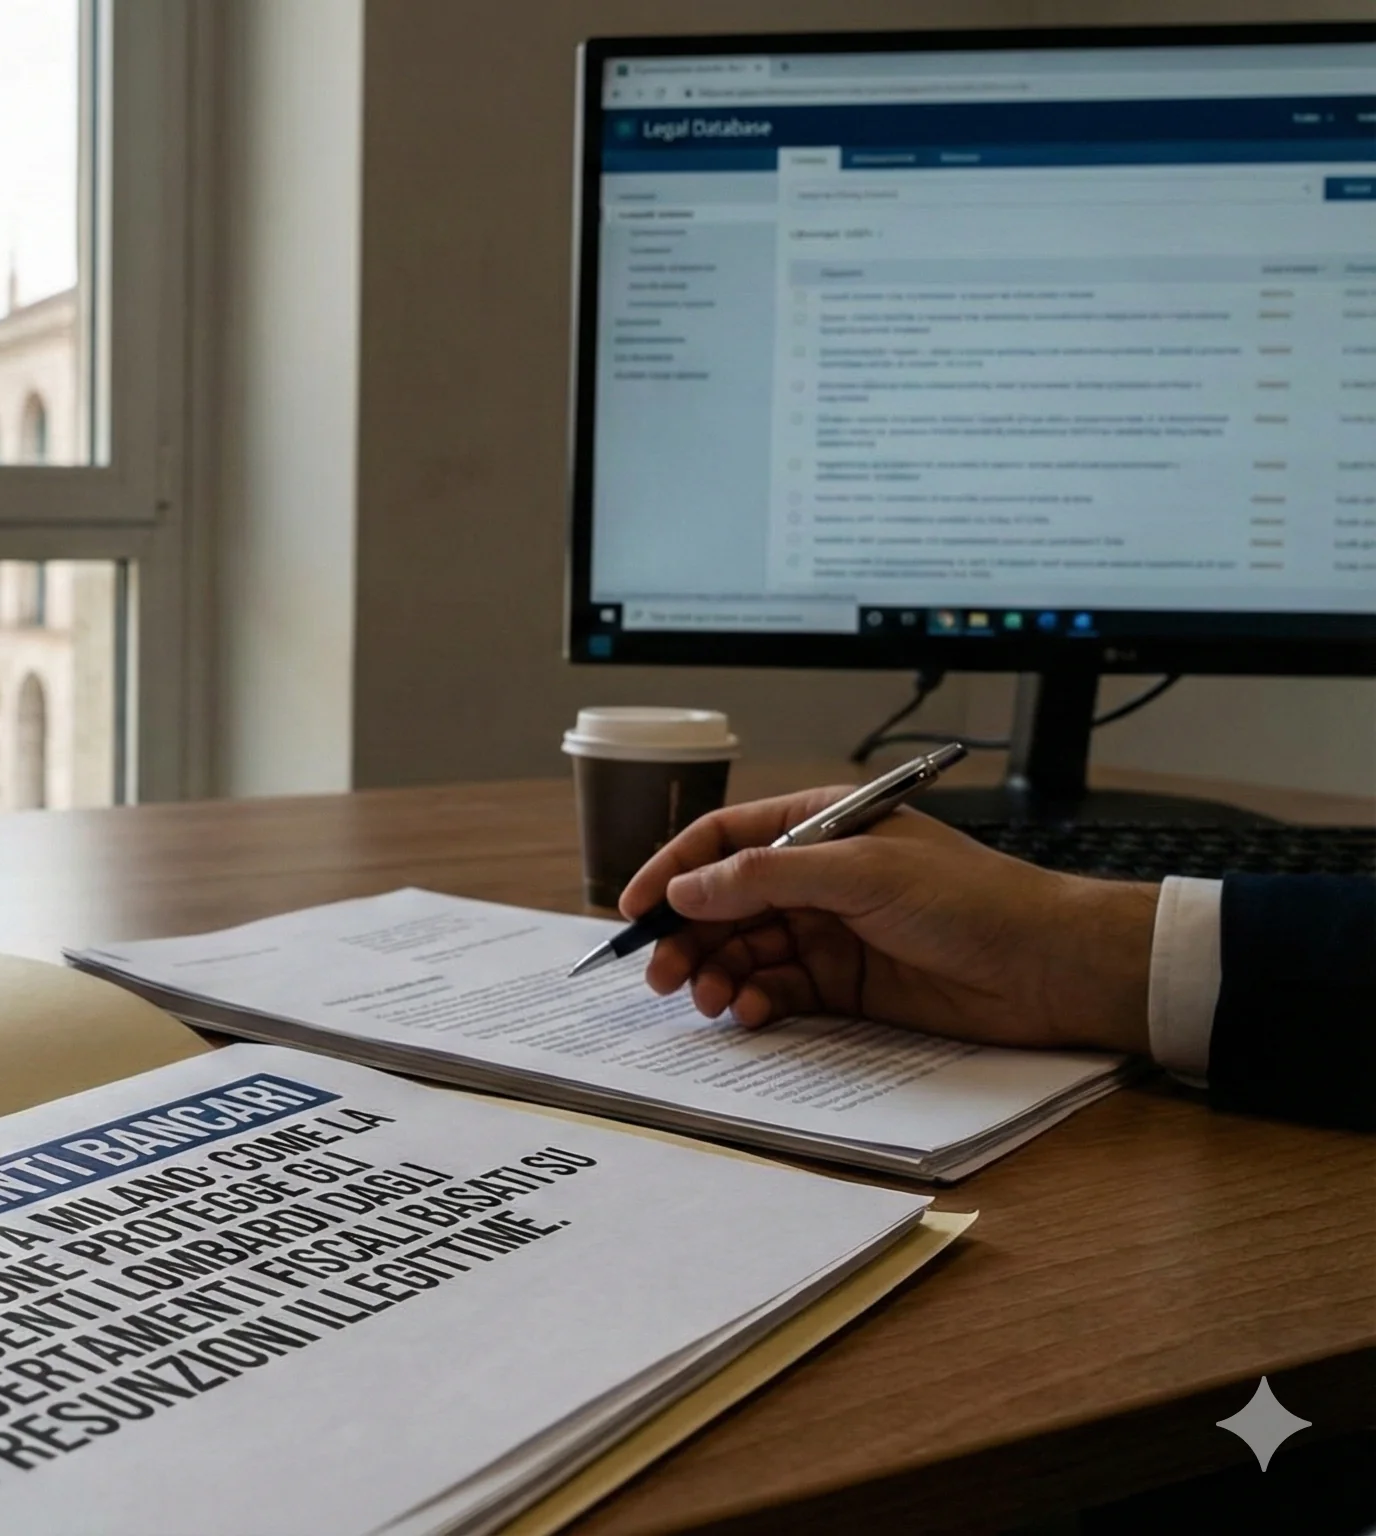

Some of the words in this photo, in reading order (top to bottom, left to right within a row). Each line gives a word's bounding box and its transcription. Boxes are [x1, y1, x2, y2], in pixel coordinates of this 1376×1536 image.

[642, 118, 691, 142] Legal
[692, 116, 772, 138] Database
[25, 1165, 233, 1235] MILANO:
[206, 1122, 344, 1171] COME
[312, 1107, 396, 1135] LA
[59, 1079, 317, 1167] BANCARI
[58, 1172, 313, 1266] PROTEGGE
[281, 1150, 375, 1184] GLI
[89, 1202, 346, 1302] LOMBARDI
[312, 1161, 454, 1215] DAGLI
[247, 1214, 433, 1289] FISCALI
[394, 1165, 555, 1228] BASATI
[519, 1145, 597, 1176] SU
[280, 1209, 572, 1330] ILLEGITTIME.
